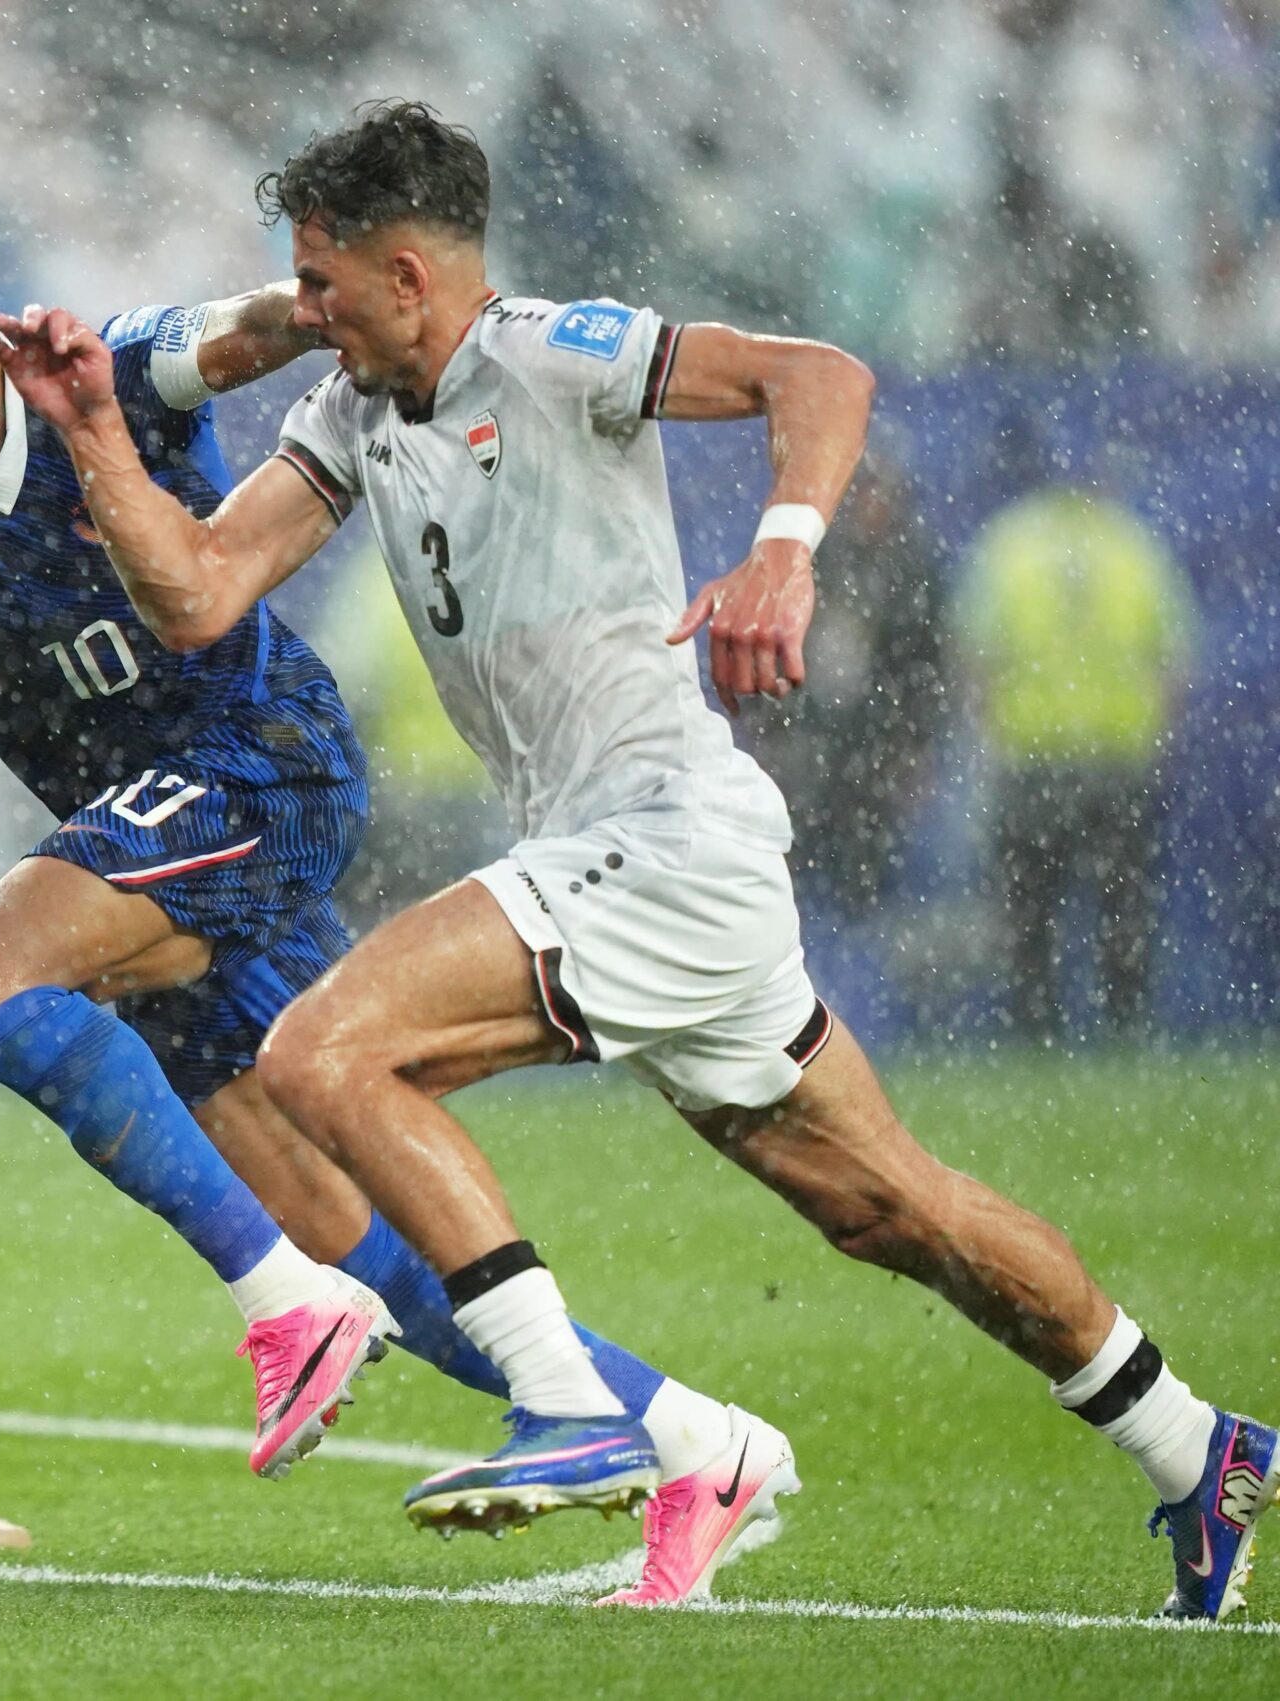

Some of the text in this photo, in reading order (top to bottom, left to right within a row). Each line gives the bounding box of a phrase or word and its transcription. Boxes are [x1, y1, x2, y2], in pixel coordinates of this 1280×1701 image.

[366, 439, 392, 466] JAK
[421, 520, 464, 637] 3
[40, 619, 140, 700] 10
